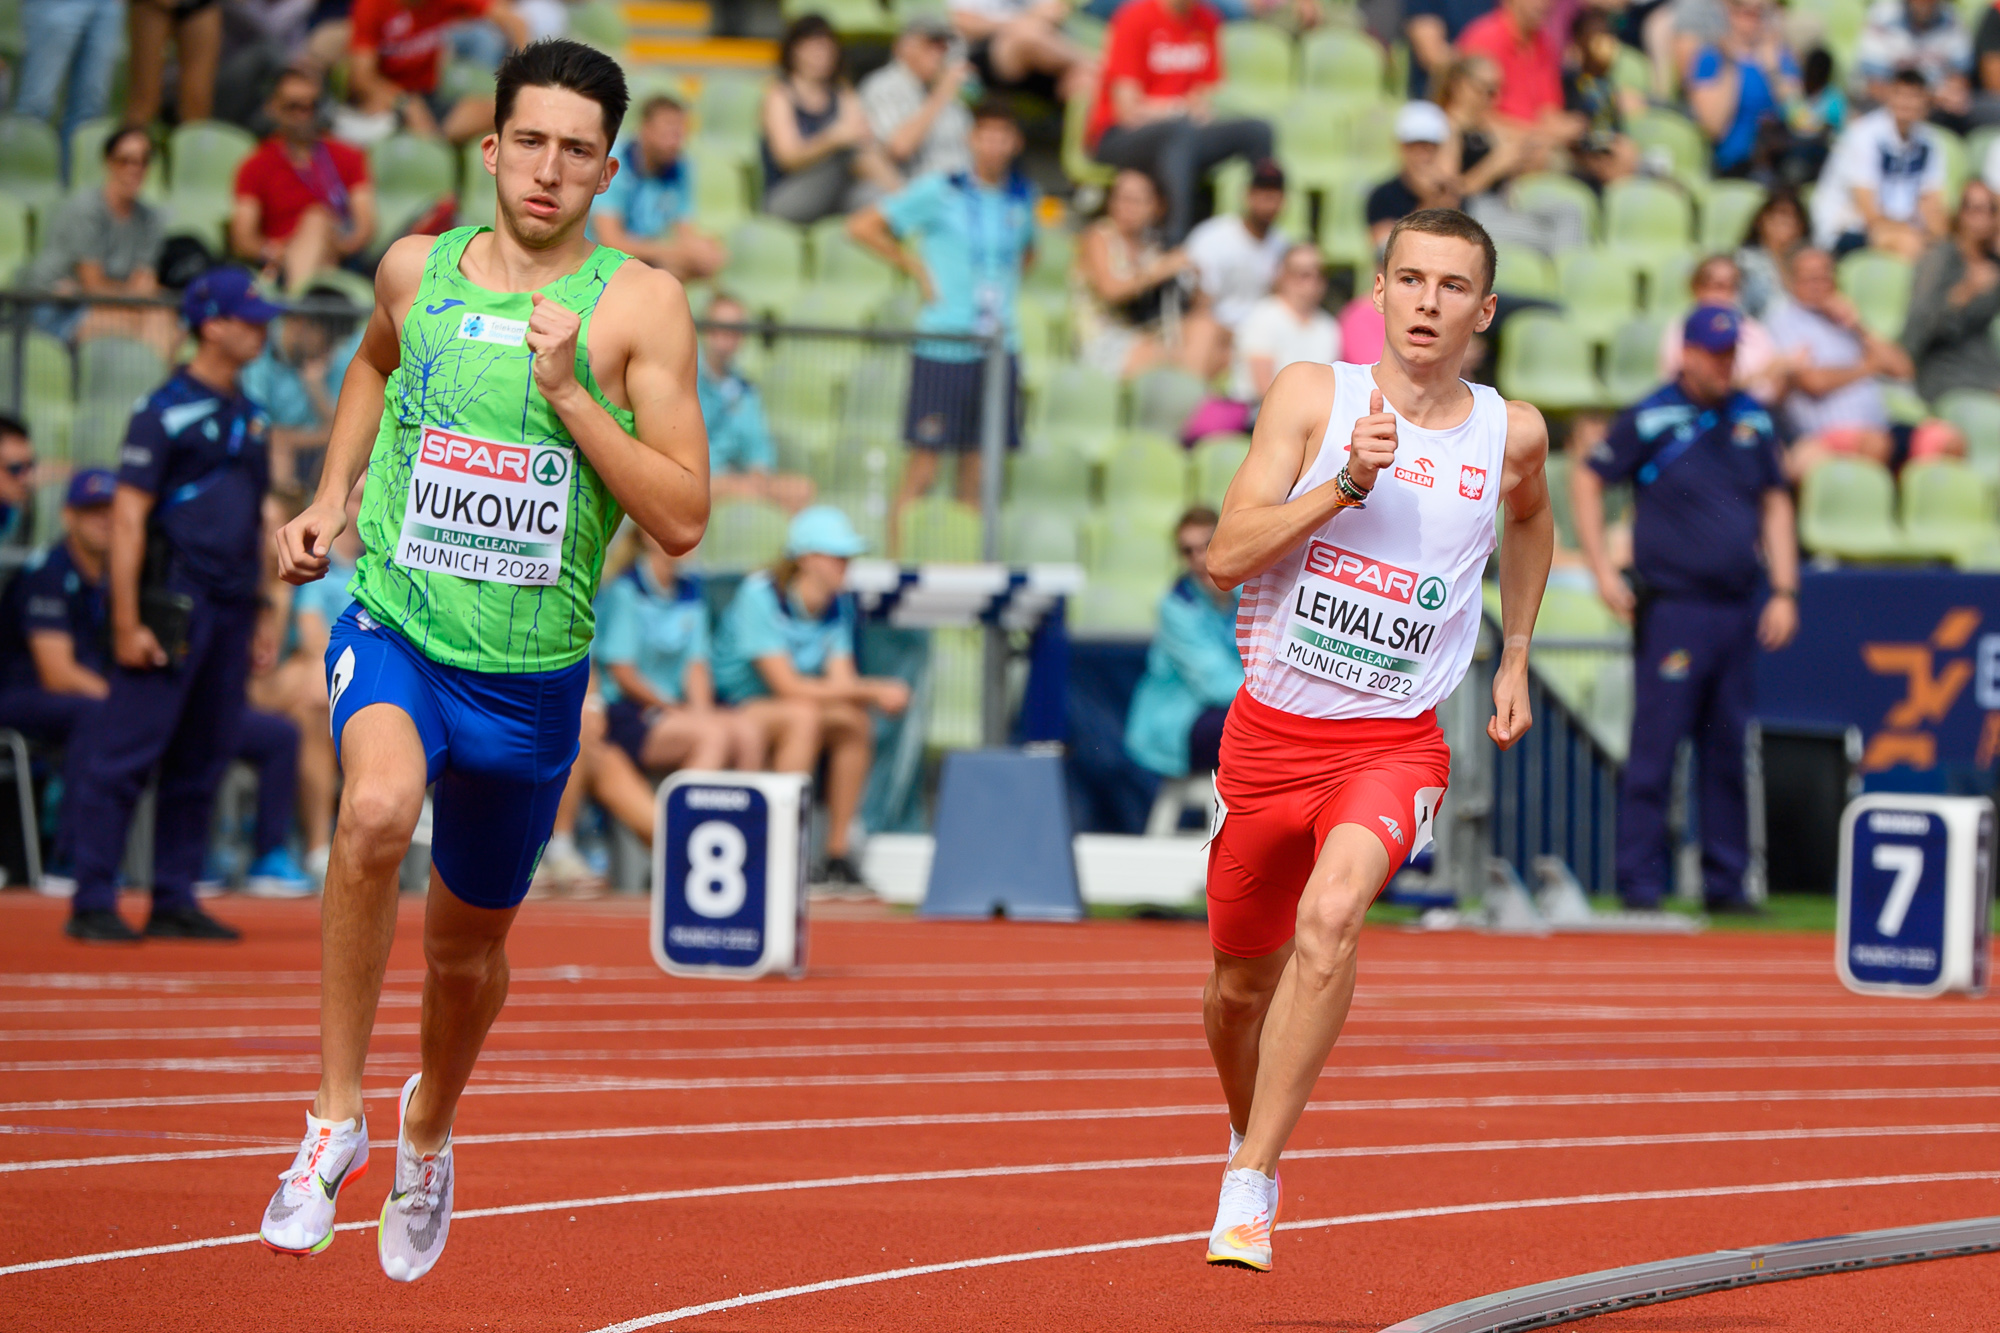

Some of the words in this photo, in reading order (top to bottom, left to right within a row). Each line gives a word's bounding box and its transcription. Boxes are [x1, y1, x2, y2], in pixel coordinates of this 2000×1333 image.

[491, 321, 525, 334] Telekom
[423, 434, 527, 478] SPAR
[1396, 469, 1432, 487] ORLEN
[414, 479, 560, 535] VUKOVIC
[406, 542, 489, 574] MUNICH
[496, 558, 550, 580] 2022
[433, 529, 439, 540] I
[441, 530, 472, 546] RUN
[1309, 546, 1414, 600] SPAR
[1294, 585, 1436, 655] LEWALSKI
[1286, 641, 1363, 683] MUNICH
[1367, 671, 1413, 696] 2022
[1314, 634, 1321, 645] I
[1321, 637, 1350, 656] RUN
[684, 819, 748, 919] 8
[1872, 843, 1925, 938] 7
